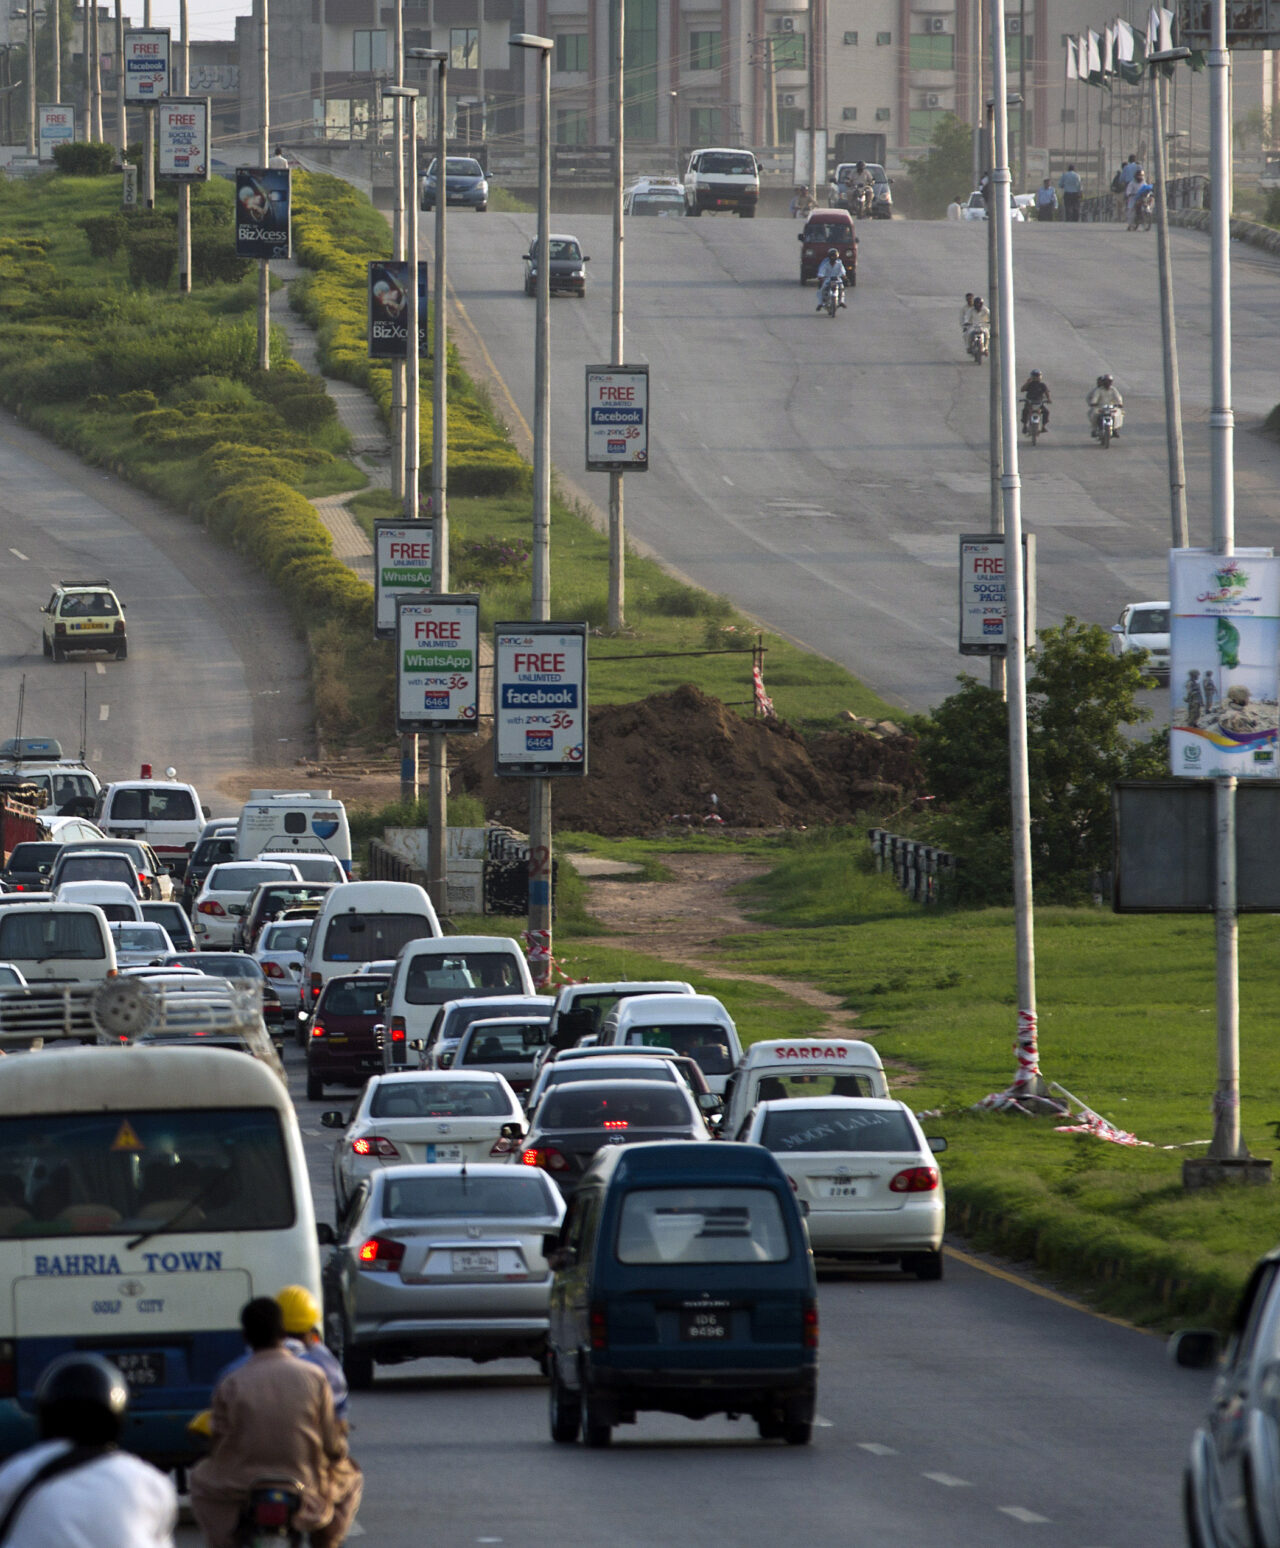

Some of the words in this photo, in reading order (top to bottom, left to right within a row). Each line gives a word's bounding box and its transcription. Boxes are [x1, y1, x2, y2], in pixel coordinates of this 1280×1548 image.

[133, 44, 159, 54] FREE
[130, 62, 162, 70] facebook
[46, 114, 66, 123] FREE
[168, 114, 196, 125] FREE
[238, 228, 287, 241] BizXcess
[373, 326, 425, 338] BizXcs
[600, 386, 635, 400] FREE
[594, 411, 639, 421] facebook
[624, 428, 640, 439] 3G
[390, 543, 430, 559] FREE
[974, 558, 1006, 573] FRE
[383, 571, 431, 584] WhatsAp
[974, 584, 1006, 592] SOCIA
[415, 622, 460, 639] FREE
[406, 655, 470, 668] WhatsApp
[514, 653, 565, 672] FREE
[447, 677, 468, 689] 3G
[518, 674, 561, 682] UNLIMITED
[507, 689, 572, 703] facebook
[507, 717, 524, 725] with
[550, 714, 573, 729] 3G
[528, 738, 552, 747] 6464
[776, 1047, 848, 1059] SARDAR
[782, 1123, 834, 1148] MOON
[836, 1114, 890, 1131] LALA
[35, 1254, 121, 1275] BAHRIA
[142, 1252, 223, 1272] TOWN
[137, 1299, 164, 1313] CITY
